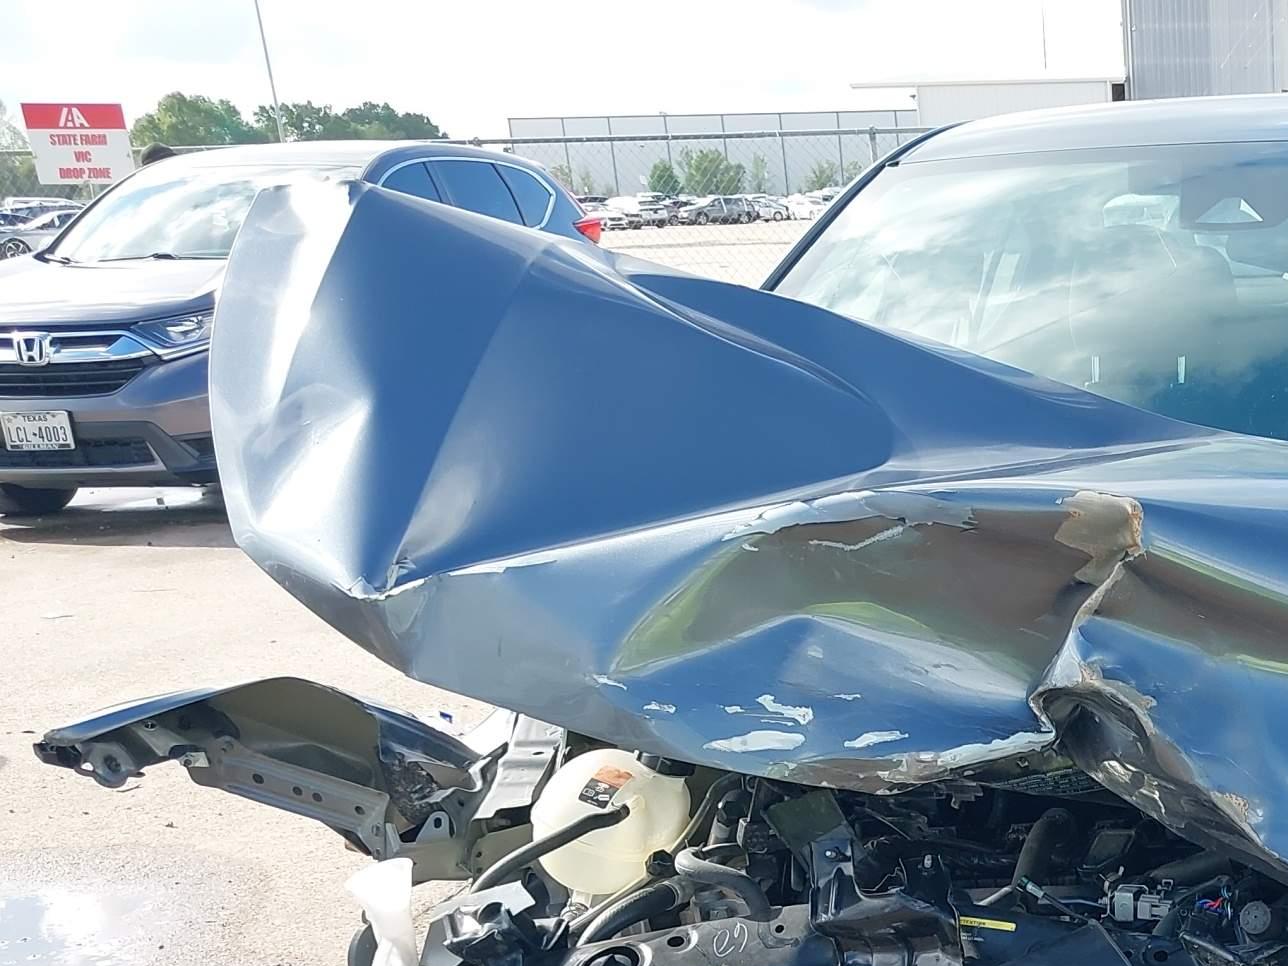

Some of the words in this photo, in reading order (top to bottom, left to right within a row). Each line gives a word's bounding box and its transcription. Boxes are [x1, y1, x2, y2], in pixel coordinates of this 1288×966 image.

[49, 134, 79, 145] STATE
[80, 134, 107, 145] FARM
[74, 151, 92, 162] VIC
[59, 167, 85, 179] DROP
[87, 167, 112, 179] ZONE
